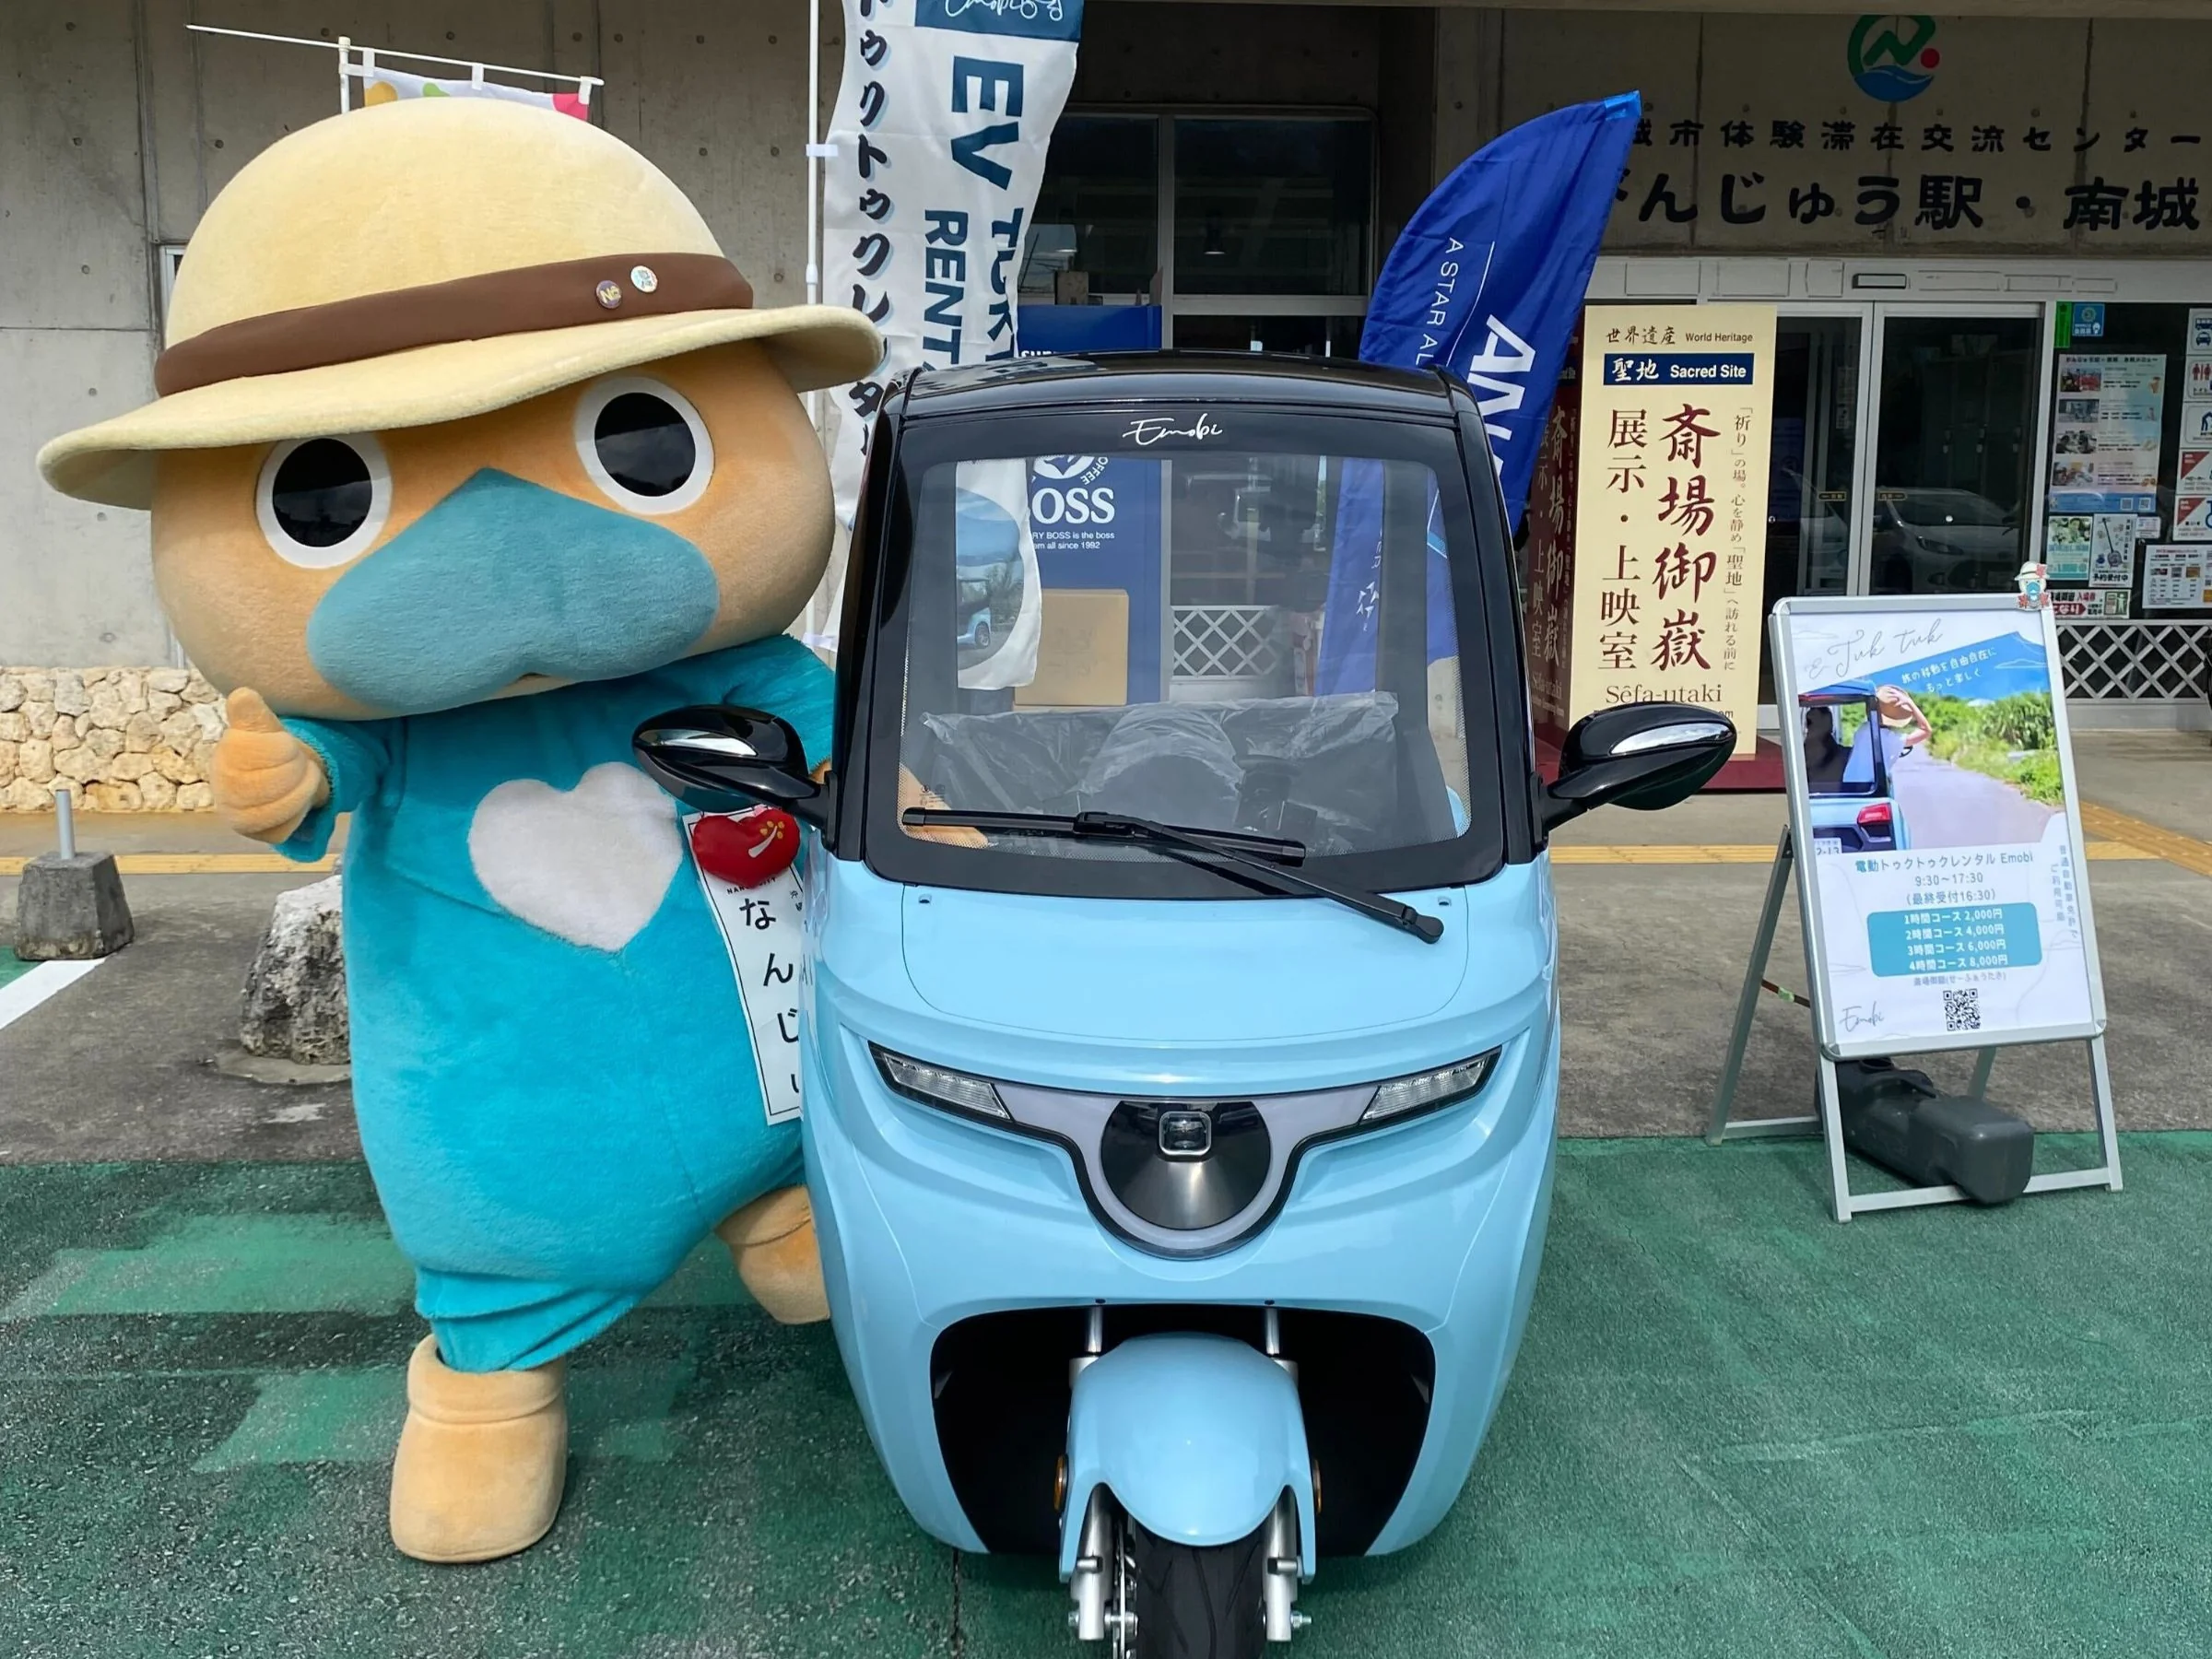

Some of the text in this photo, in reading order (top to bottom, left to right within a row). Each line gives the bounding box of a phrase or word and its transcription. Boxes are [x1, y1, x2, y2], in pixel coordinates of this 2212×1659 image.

[950, 55, 1025, 360] EV TUKT
[922, 209, 969, 371] RENT
[1415, 237, 1464, 366] A STAR AL
[1606, 325, 1753, 346] 世界遺産 World Heritage
[1612, 357, 1747, 382] 聖地 Sacred Site
[1467, 313, 1536, 479] AN
[1080, 457, 1109, 486] OFFEE
[1031, 487, 1116, 525] OSS
[1046, 532, 1071, 540] BOSS
[1072, 532, 1079, 540] is
[1081, 531, 1094, 540] the
[1096, 531, 1115, 540] boss
[1046, 541, 1056, 550] all
[1057, 541, 1079, 550] since
[1081, 541, 1100, 550] 1992
[1598, 408, 1649, 670] 展示・上映室
[1650, 404, 1722, 671] 斎場御嶽
[1606, 684, 1723, 703] Sêfa-utaki
[1855, 851, 2034, 873] 電動トゥクトゥクレンタル Emobi
[1904, 908, 2003, 925] 1時間コース 2,000円
[1905, 924, 2005, 940] 2時間コース 4,000円
[1907, 939, 2006, 956] 3時間コース 6,000円
[1909, 954, 2008, 971] 4時間コース 8,000円
[738, 897, 800, 1094] なんじ
